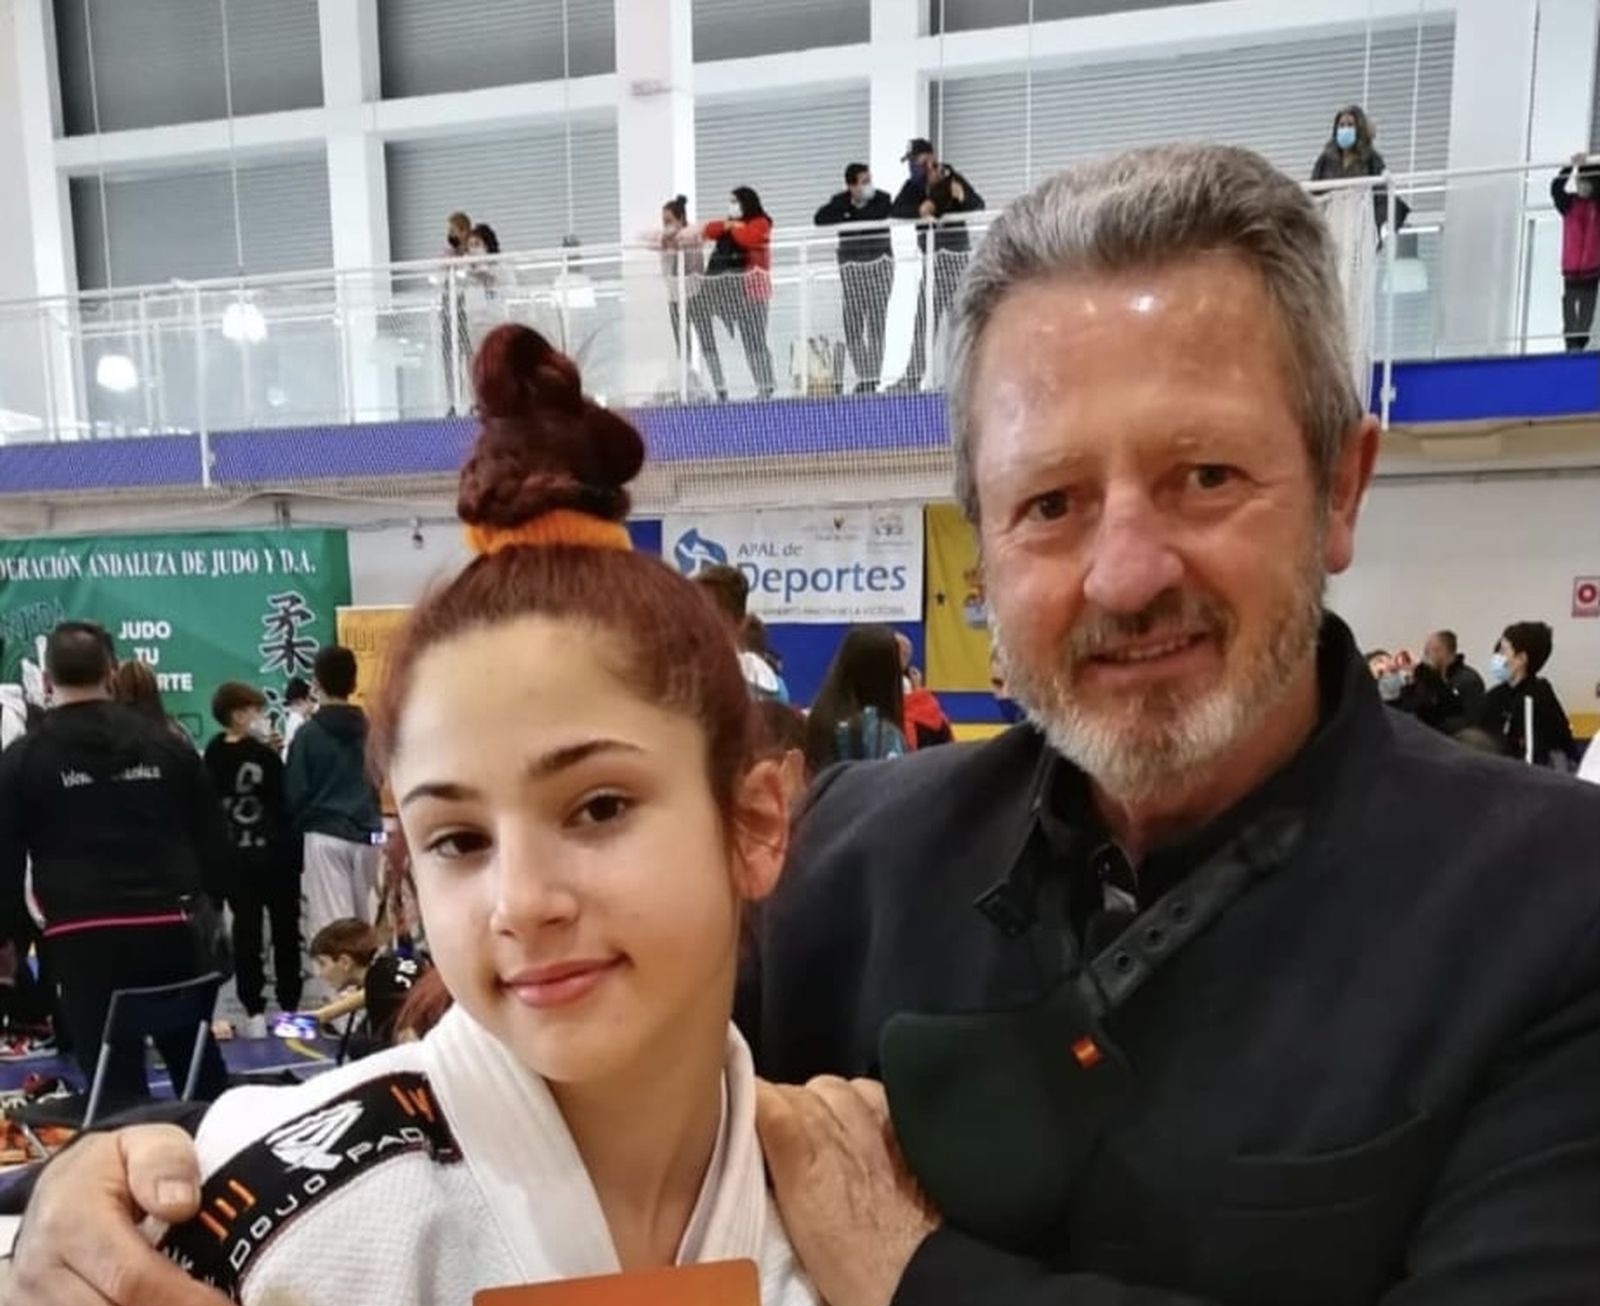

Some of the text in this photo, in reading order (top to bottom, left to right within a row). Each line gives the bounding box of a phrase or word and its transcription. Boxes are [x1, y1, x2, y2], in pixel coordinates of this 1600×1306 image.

[89, 550, 176, 577] ANDALUZA
[181, 549, 207, 576] DE
[211, 549, 258, 577] JUDO
[263, 549, 275, 575] Y
[281, 549, 316, 574] D.A.
[736, 560, 907, 603] Deportes
[117, 620, 171, 640] JUDO
[134, 646, 159, 665] TU
